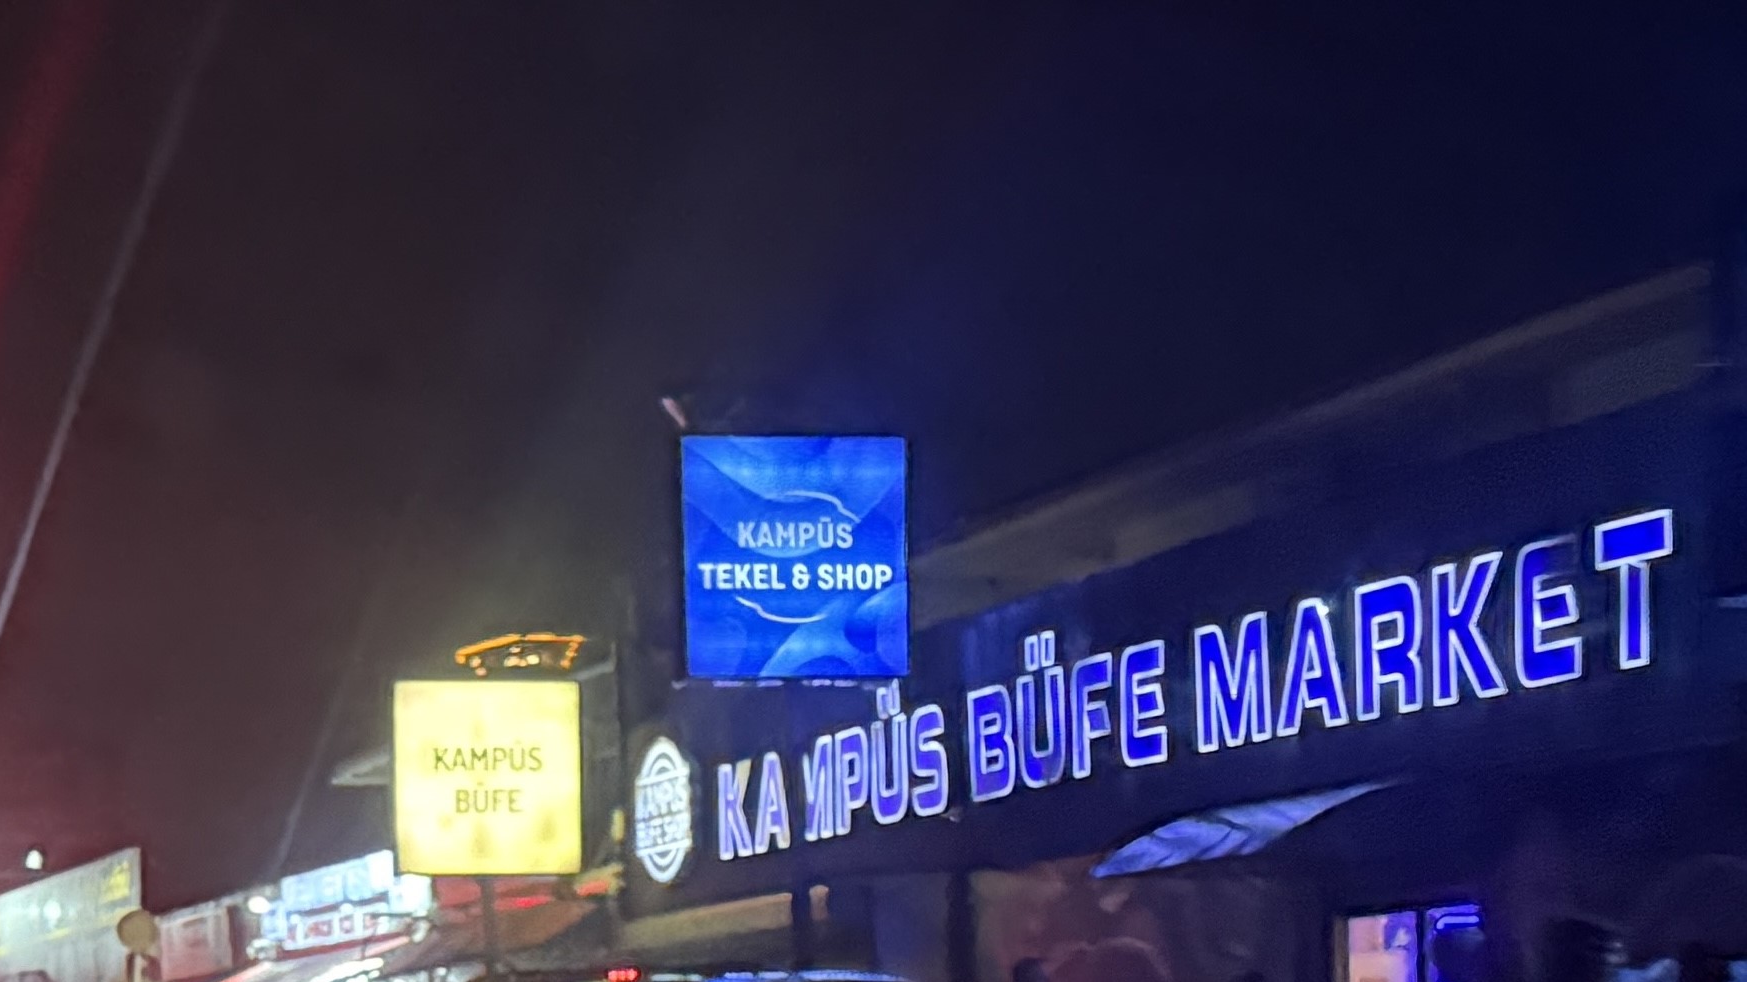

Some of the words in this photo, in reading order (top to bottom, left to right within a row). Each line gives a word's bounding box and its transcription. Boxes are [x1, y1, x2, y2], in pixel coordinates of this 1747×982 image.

[737, 516, 854, 549] KAMPÜS
[697, 563, 786, 590] TEKEL
[791, 563, 811, 590] &
[817, 563, 893, 590] SHOP
[966, 629, 1169, 802] BÜFE
[1193, 508, 1674, 754] MARKET
[432, 740, 543, 772] KAMPÜS
[455, 780, 524, 814] BÜFE
